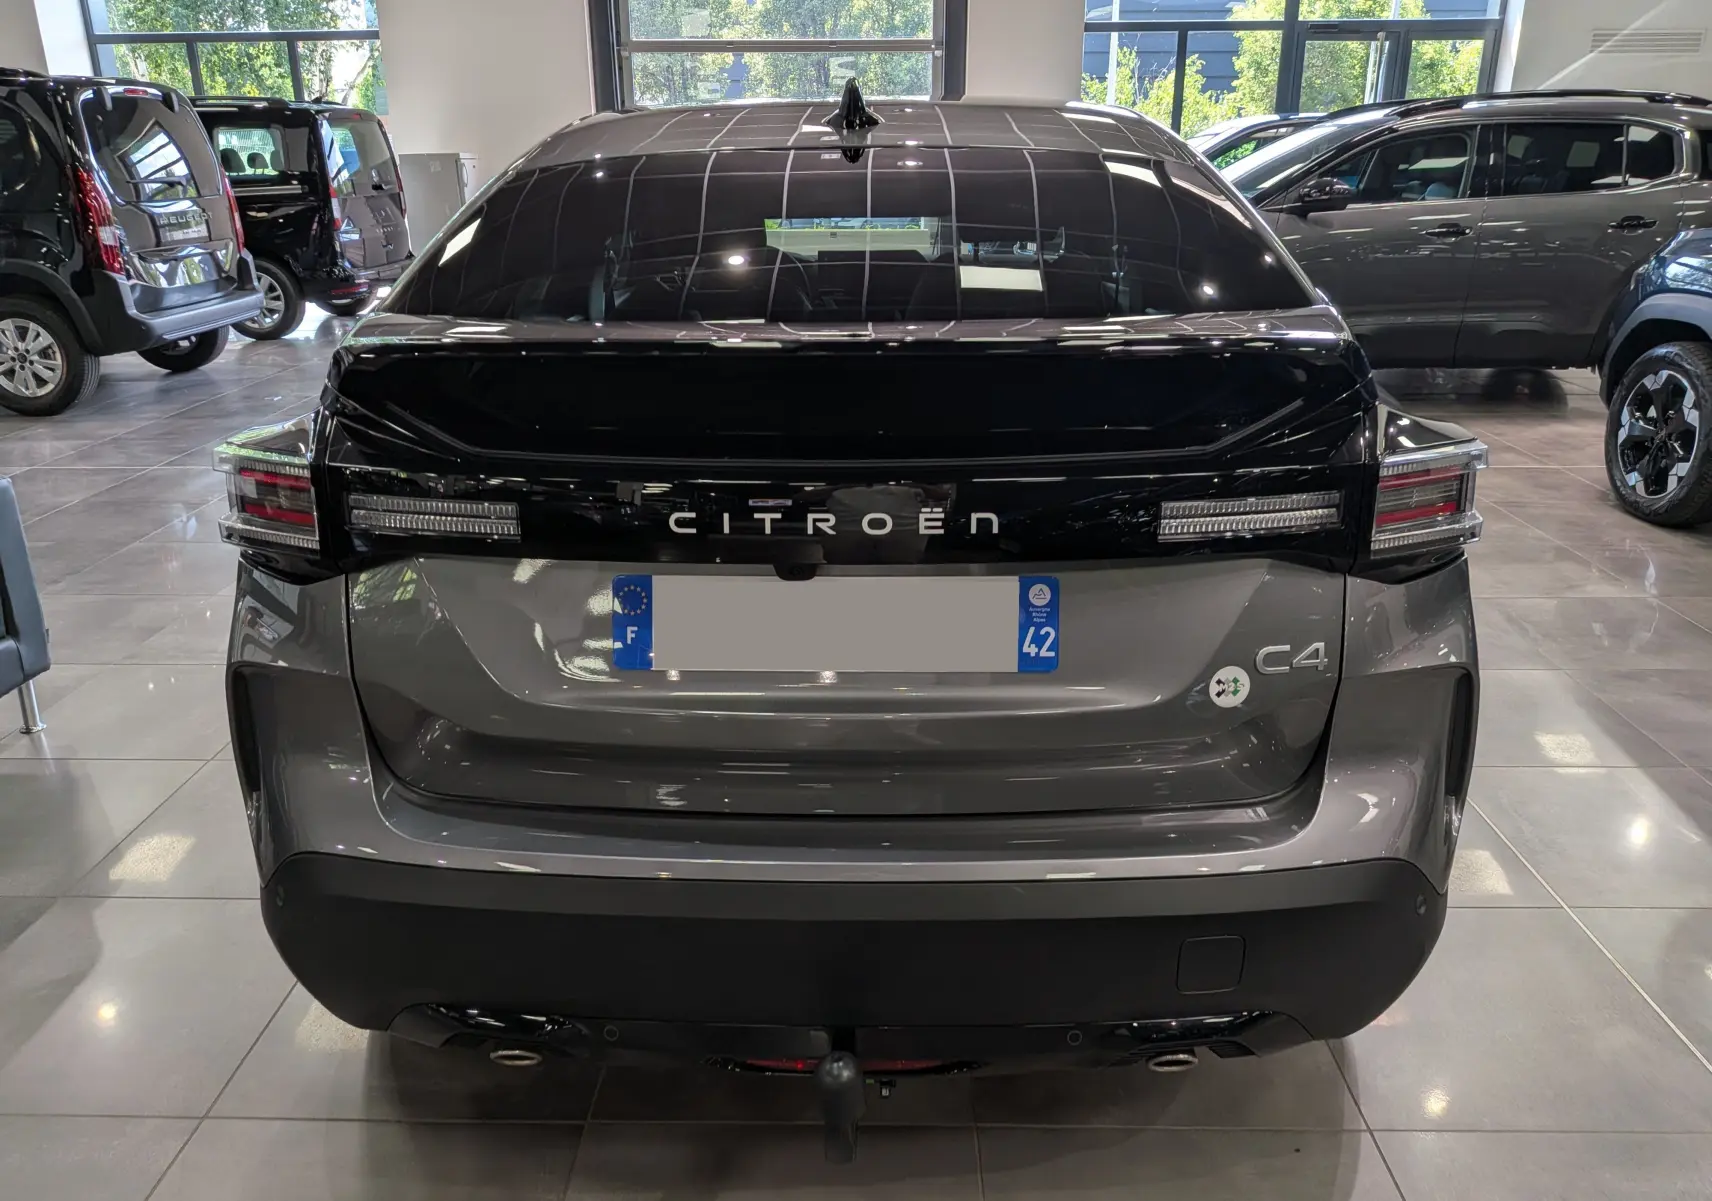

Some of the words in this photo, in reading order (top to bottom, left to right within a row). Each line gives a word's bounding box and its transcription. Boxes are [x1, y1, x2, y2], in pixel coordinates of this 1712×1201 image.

[668, 507, 999, 536] CITROËN
[626, 626, 639, 645] F
[1022, 626, 1056, 657] 42
[1255, 641, 1328, 675] C4
